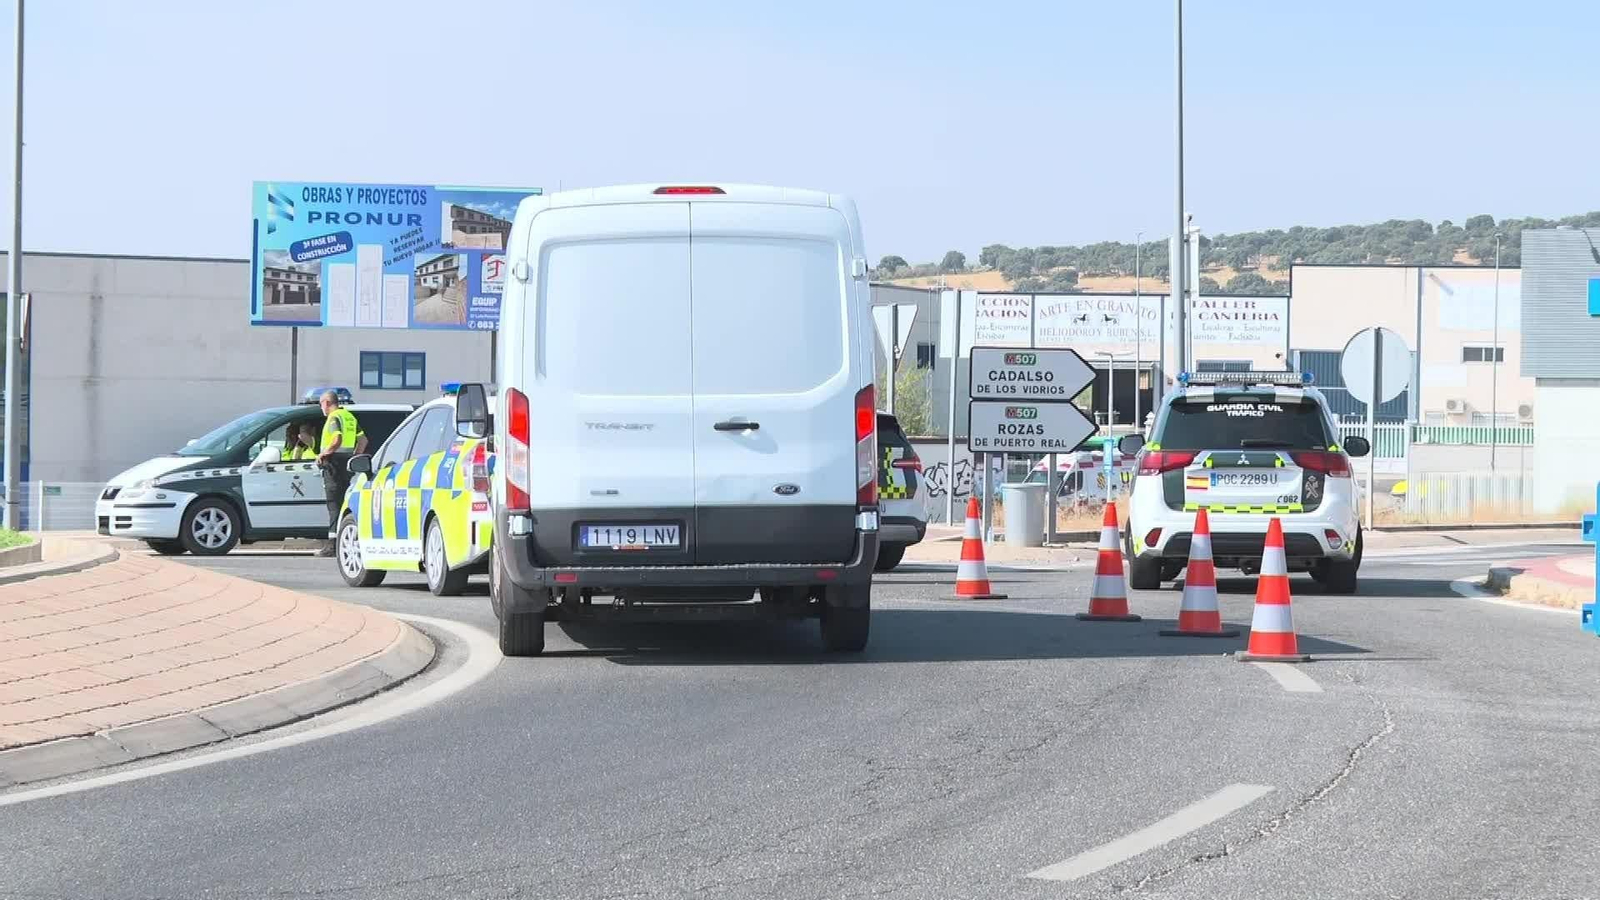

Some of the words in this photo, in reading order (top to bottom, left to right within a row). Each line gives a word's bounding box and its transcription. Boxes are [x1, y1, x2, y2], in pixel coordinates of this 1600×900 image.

[302, 186, 342, 204] OBRAS
[346, 187, 354, 204] Y
[357, 187, 428, 206] PROYECTOS
[307, 211, 423, 227] PRONUR
[311, 238, 327, 248] FASE
[327, 234, 337, 244] EN
[390, 237, 399, 246] YA
[400, 227, 424, 241] PUEDES
[393, 236, 424, 254] RESERVAR
[297, 243, 348, 262] CONSTRUCCIÓN
[383, 259, 393, 267] TU
[392, 250, 413, 263] NUEVO
[413, 241, 434, 255] HOGAR
[471, 296, 498, 307] EQUIP
[978, 298, 1030, 307] CCION
[1192, 300, 1257, 309] TALLER
[1039, 302, 1070, 320] ARTE
[1076, 299, 1094, 312] EN
[1198, 312, 1280, 321] CANTERIA
[1039, 327, 1095, 337] HELIODORO
[988, 369, 1055, 383] CADALSO
[976, 384, 991, 394] DE
[996, 385, 1016, 394] LOS
[1022, 385, 1066, 395] VIDRIOS
[1206, 403, 1255, 412] GUARDIA
[1257, 404, 1284, 412] CIVIL
[584, 421, 655, 431] TRANSIT
[997, 423, 1045, 435] ROZAS
[974, 438, 989, 447] DE
[993, 438, 1036, 448] PUERTO
[1040, 439, 1068, 448] REAL
[1216, 474, 1238, 485] PGC
[1240, 474, 1269, 485] 2289
[1269, 474, 1278, 485] U
[1283, 495, 1299, 503] 062
[593, 528, 637, 545] 1119
[642, 529, 676, 544] LNV
